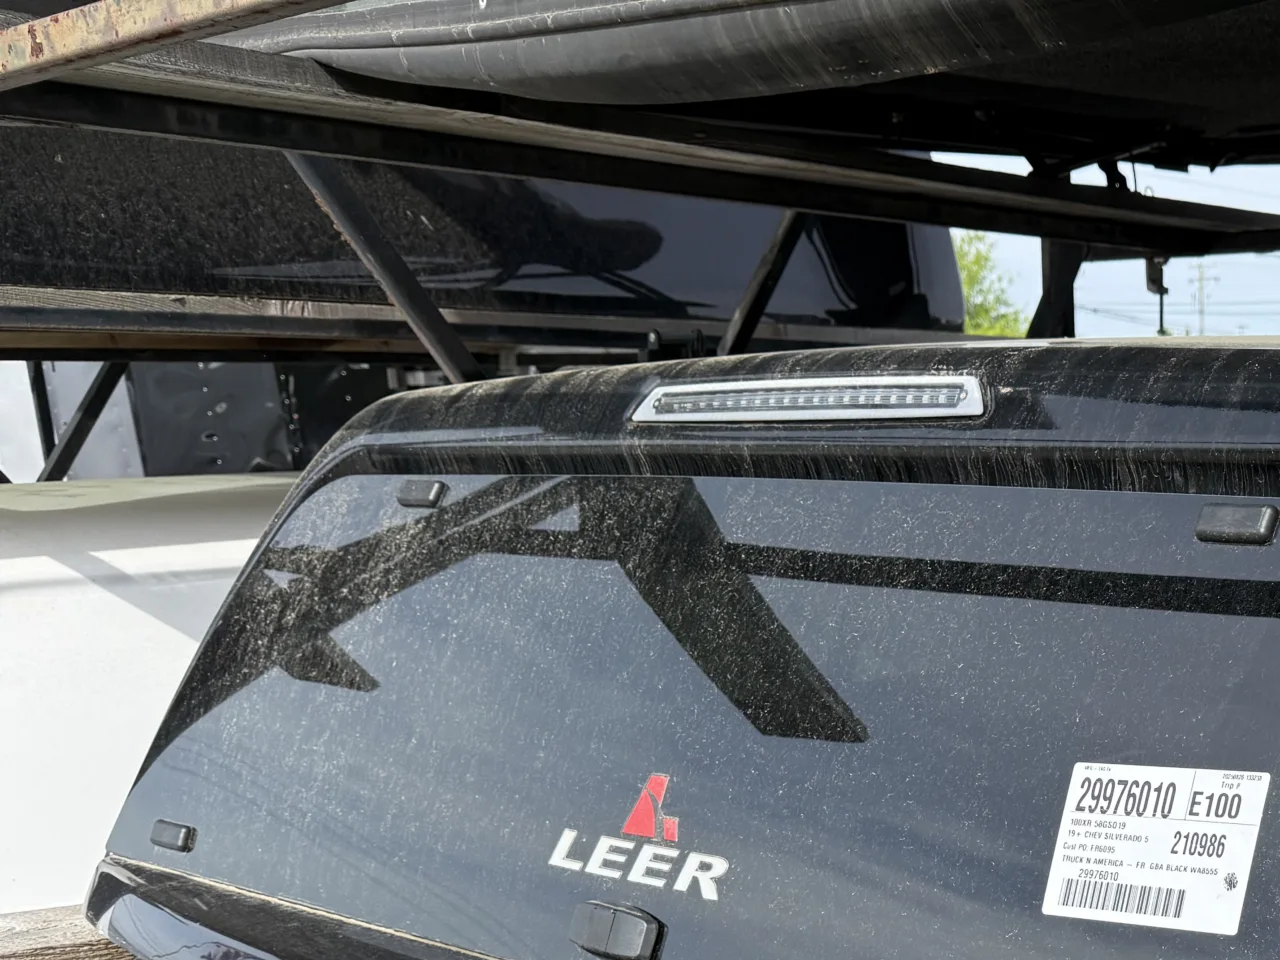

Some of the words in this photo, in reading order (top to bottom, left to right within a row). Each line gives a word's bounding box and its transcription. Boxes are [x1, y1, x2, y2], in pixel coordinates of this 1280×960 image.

[1221, 781, 1234, 790] Trip
[1075, 776, 1177, 819] 29976010
[1188, 791, 1242, 819] E100
[1084, 831, 1103, 839] CHEV
[1104, 832, 1142, 842] SILVERADO
[1144, 835, 1149, 843] 5
[1063, 841, 1077, 850] Cust
[1170, 830, 1227, 859] 210986
[548, 827, 730, 901] LEER
[1062, 854, 1083, 863] TRUCK
[1093, 857, 1124, 867] AMERICA
[1136, 861, 1146, 869] FR
[1149, 862, 1164, 870] GBA
[1166, 863, 1188, 872] BLACK
[1078, 868, 1119, 881] 29976010
